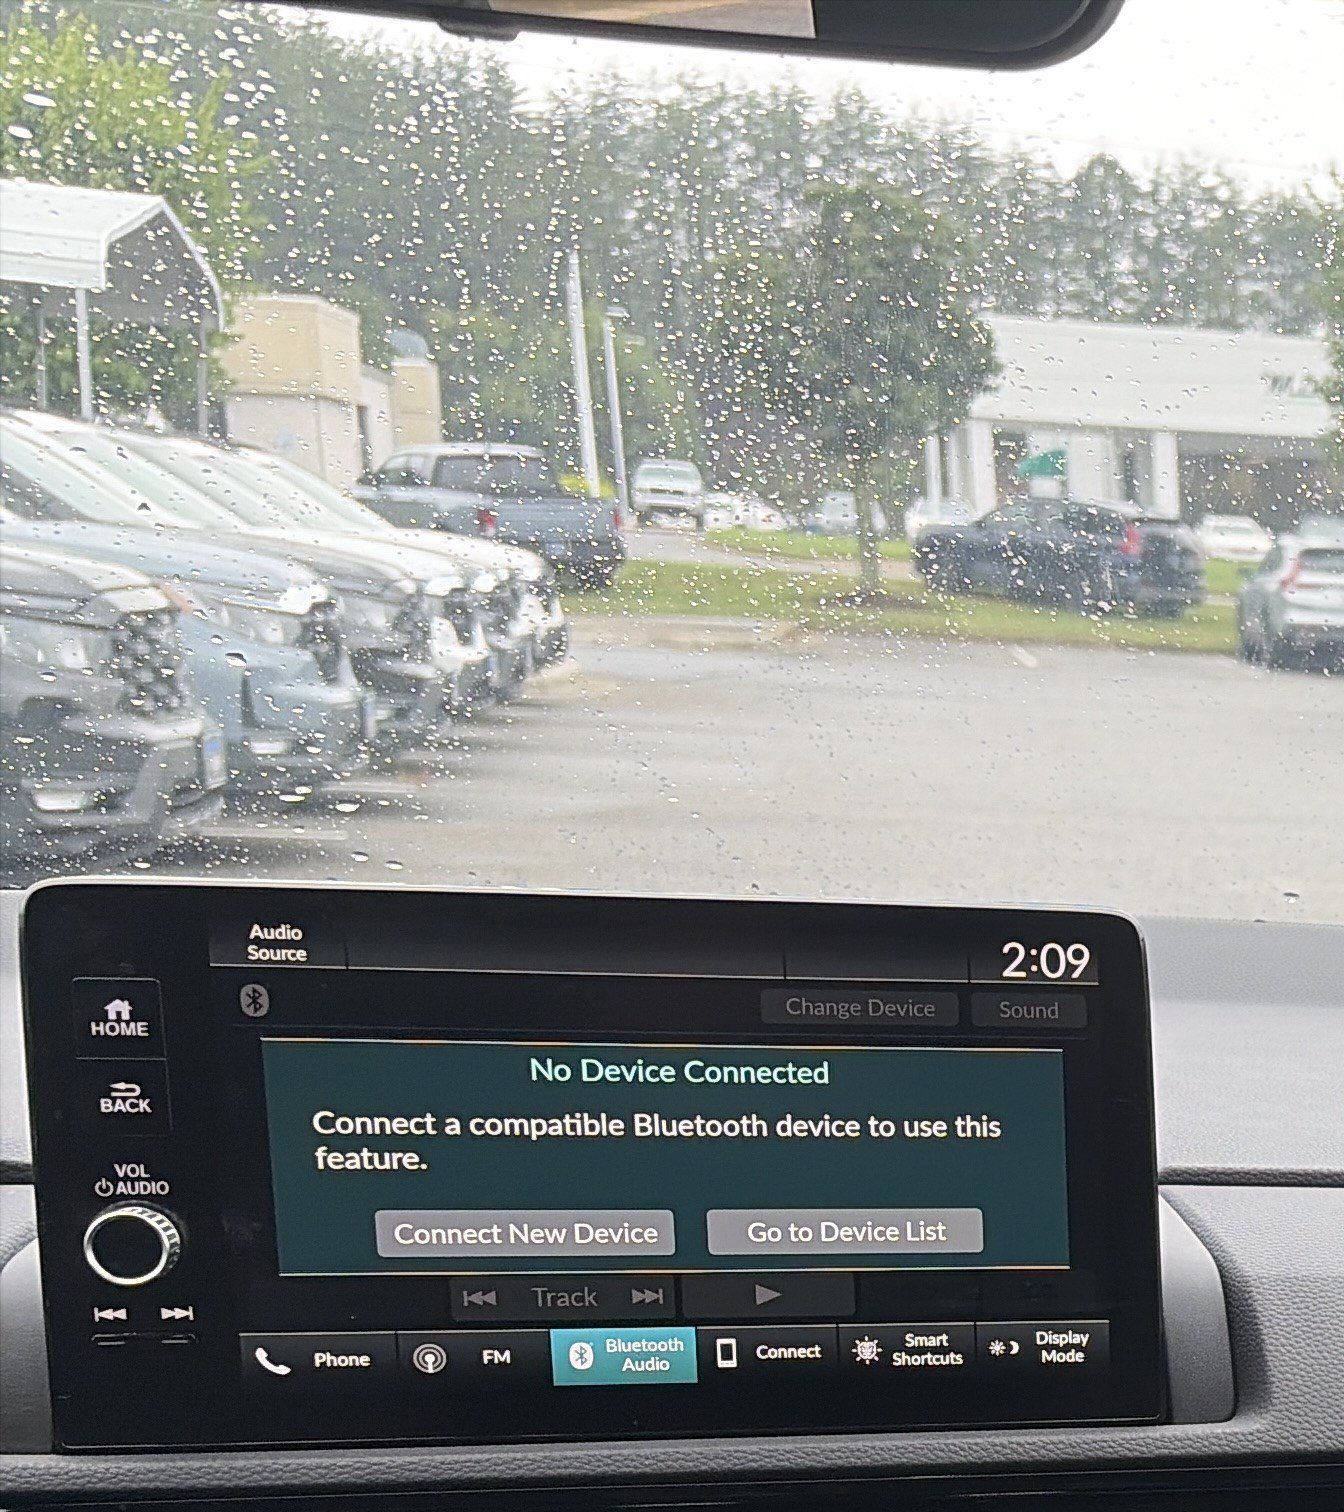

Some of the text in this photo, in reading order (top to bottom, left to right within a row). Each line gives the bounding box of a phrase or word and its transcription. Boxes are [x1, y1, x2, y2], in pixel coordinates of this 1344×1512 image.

[249, 925, 303, 941] Audio
[247, 944, 308, 962] Source
[1002, 941, 1091, 979] 2:09
[785, 998, 936, 1019] Change Device
[999, 1000, 1059, 1019] Sound
[90, 1021, 149, 1037] HOME
[530, 1058, 829, 1085] No Device Connected
[99, 1096, 152, 1114] BACK
[312, 1111, 1002, 1140] Connect a compatible Bluetooth device to use this
[315, 1145, 428, 1171] feature.
[114, 1163, 150, 1179] VOL
[116, 1180, 169, 1196] AUDIO
[394, 1223, 659, 1245] Connect New Device
[747, 1220, 947, 1244] Go to Device List
[530, 1286, 598, 1308] Track
[605, 1337, 684, 1354] Bluetooth
[904, 1333, 949, 1349] Smart
[1035, 1331, 1090, 1351] Display
[314, 1351, 371, 1369] Phone
[482, 1349, 511, 1365] FM
[755, 1343, 822, 1361] Connect
[892, 1350, 963, 1367] Shortcuts
[1041, 1347, 1085, 1364] Mode
[622, 1356, 670, 1372] Audio
